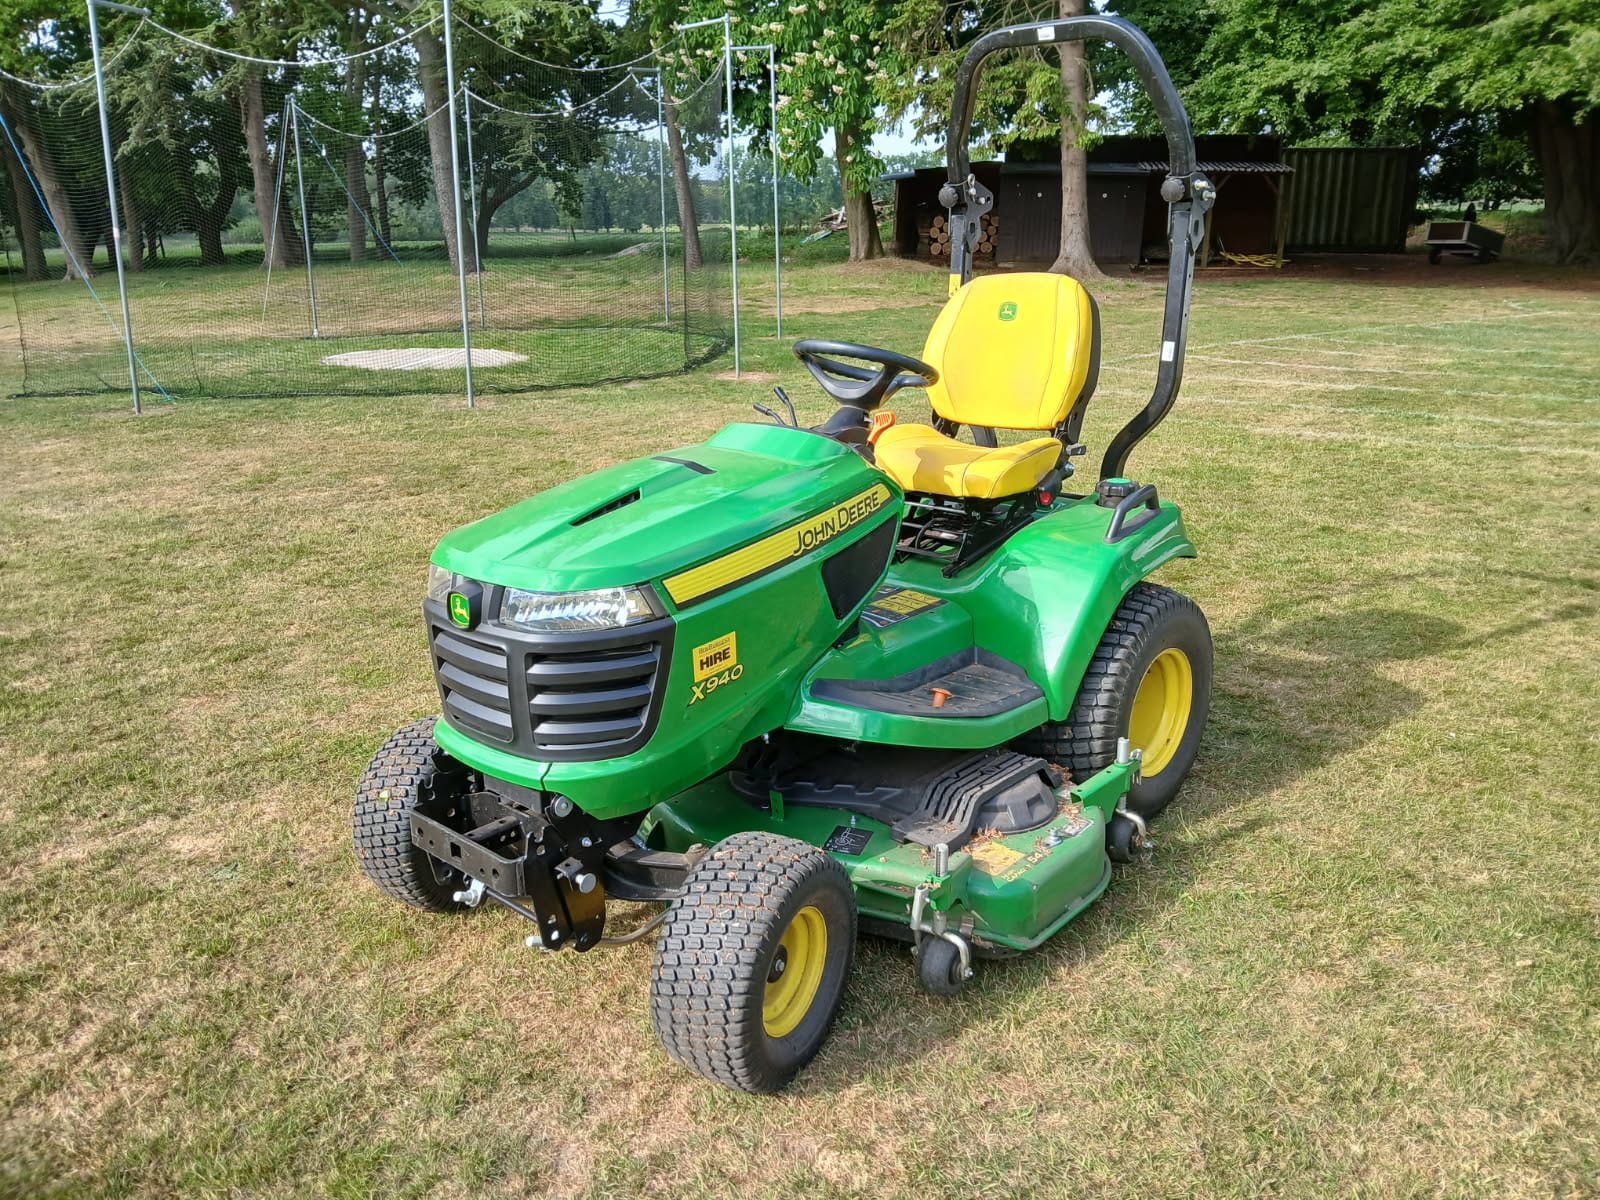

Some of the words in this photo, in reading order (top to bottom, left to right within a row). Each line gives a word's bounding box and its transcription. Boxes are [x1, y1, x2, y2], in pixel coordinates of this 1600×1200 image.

[793, 516, 836, 555] JOHN
[837, 490, 880, 529] DEERE
[699, 646, 731, 671] HIRE
[688, 664, 744, 705] X940
